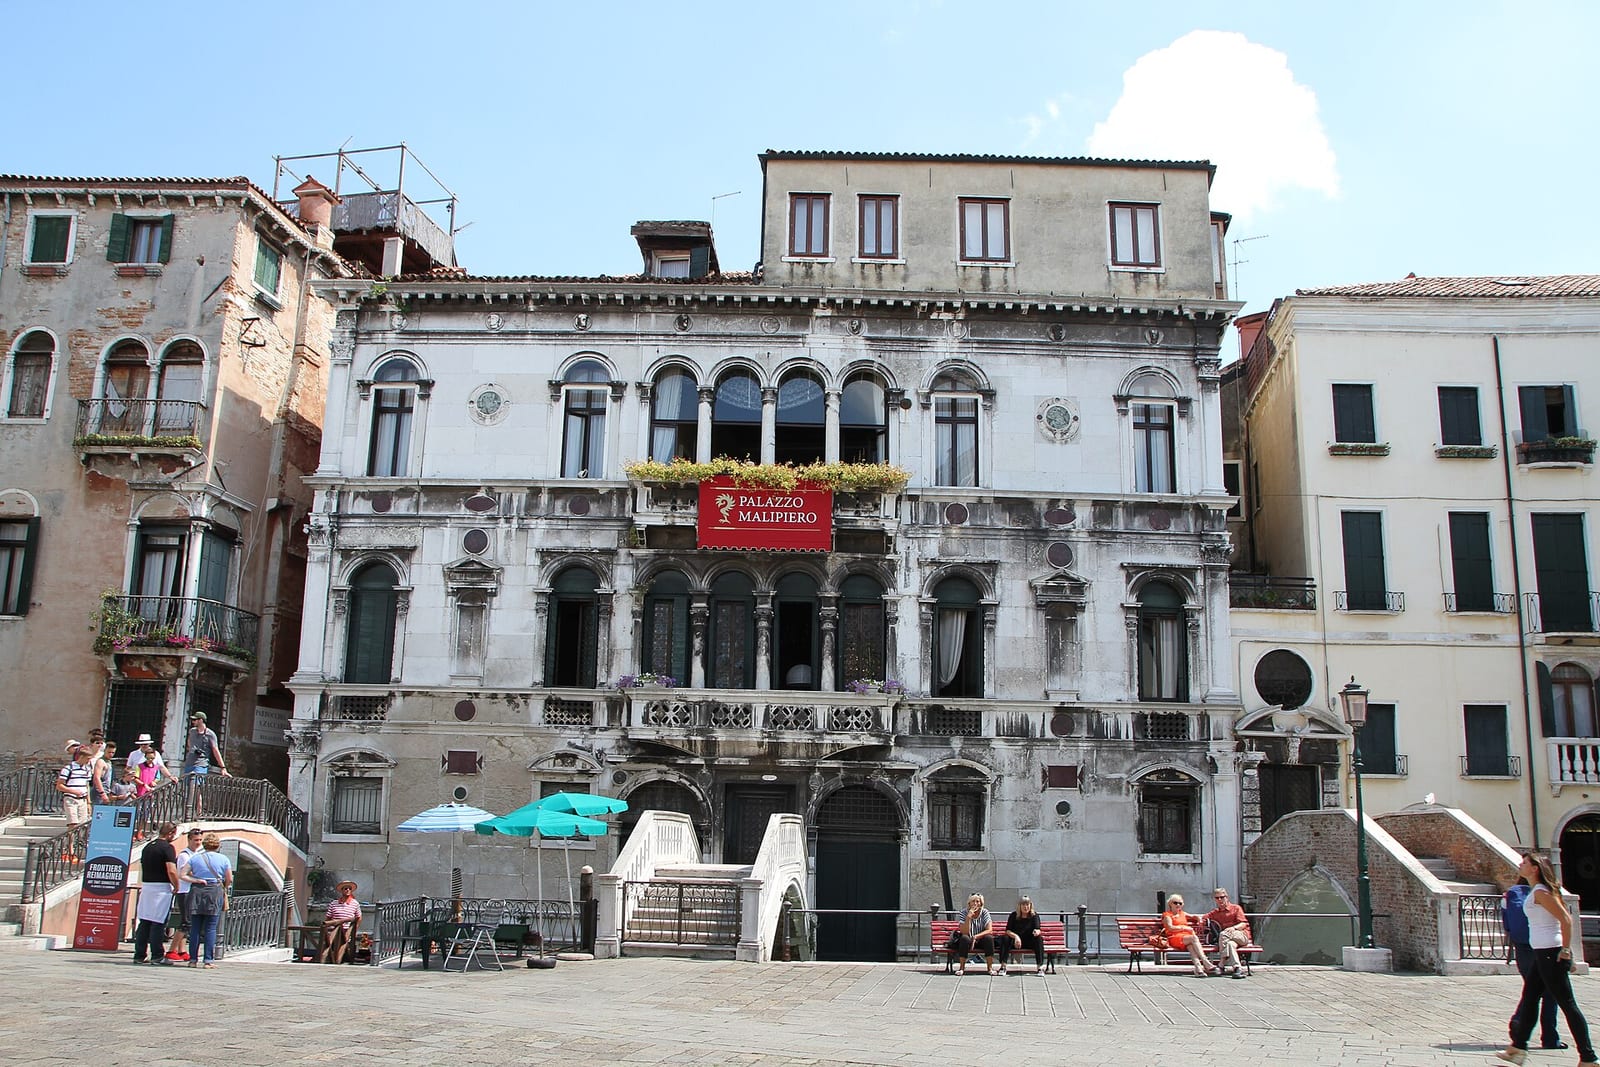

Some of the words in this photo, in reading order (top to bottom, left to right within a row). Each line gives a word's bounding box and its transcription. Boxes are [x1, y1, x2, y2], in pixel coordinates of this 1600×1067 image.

[739, 496, 804, 508] PALAZZO
[738, 511, 817, 523] MALIPIERO
[89, 863, 122, 872] FRONTIERS
[87, 871, 123, 880] REIMAGINED
